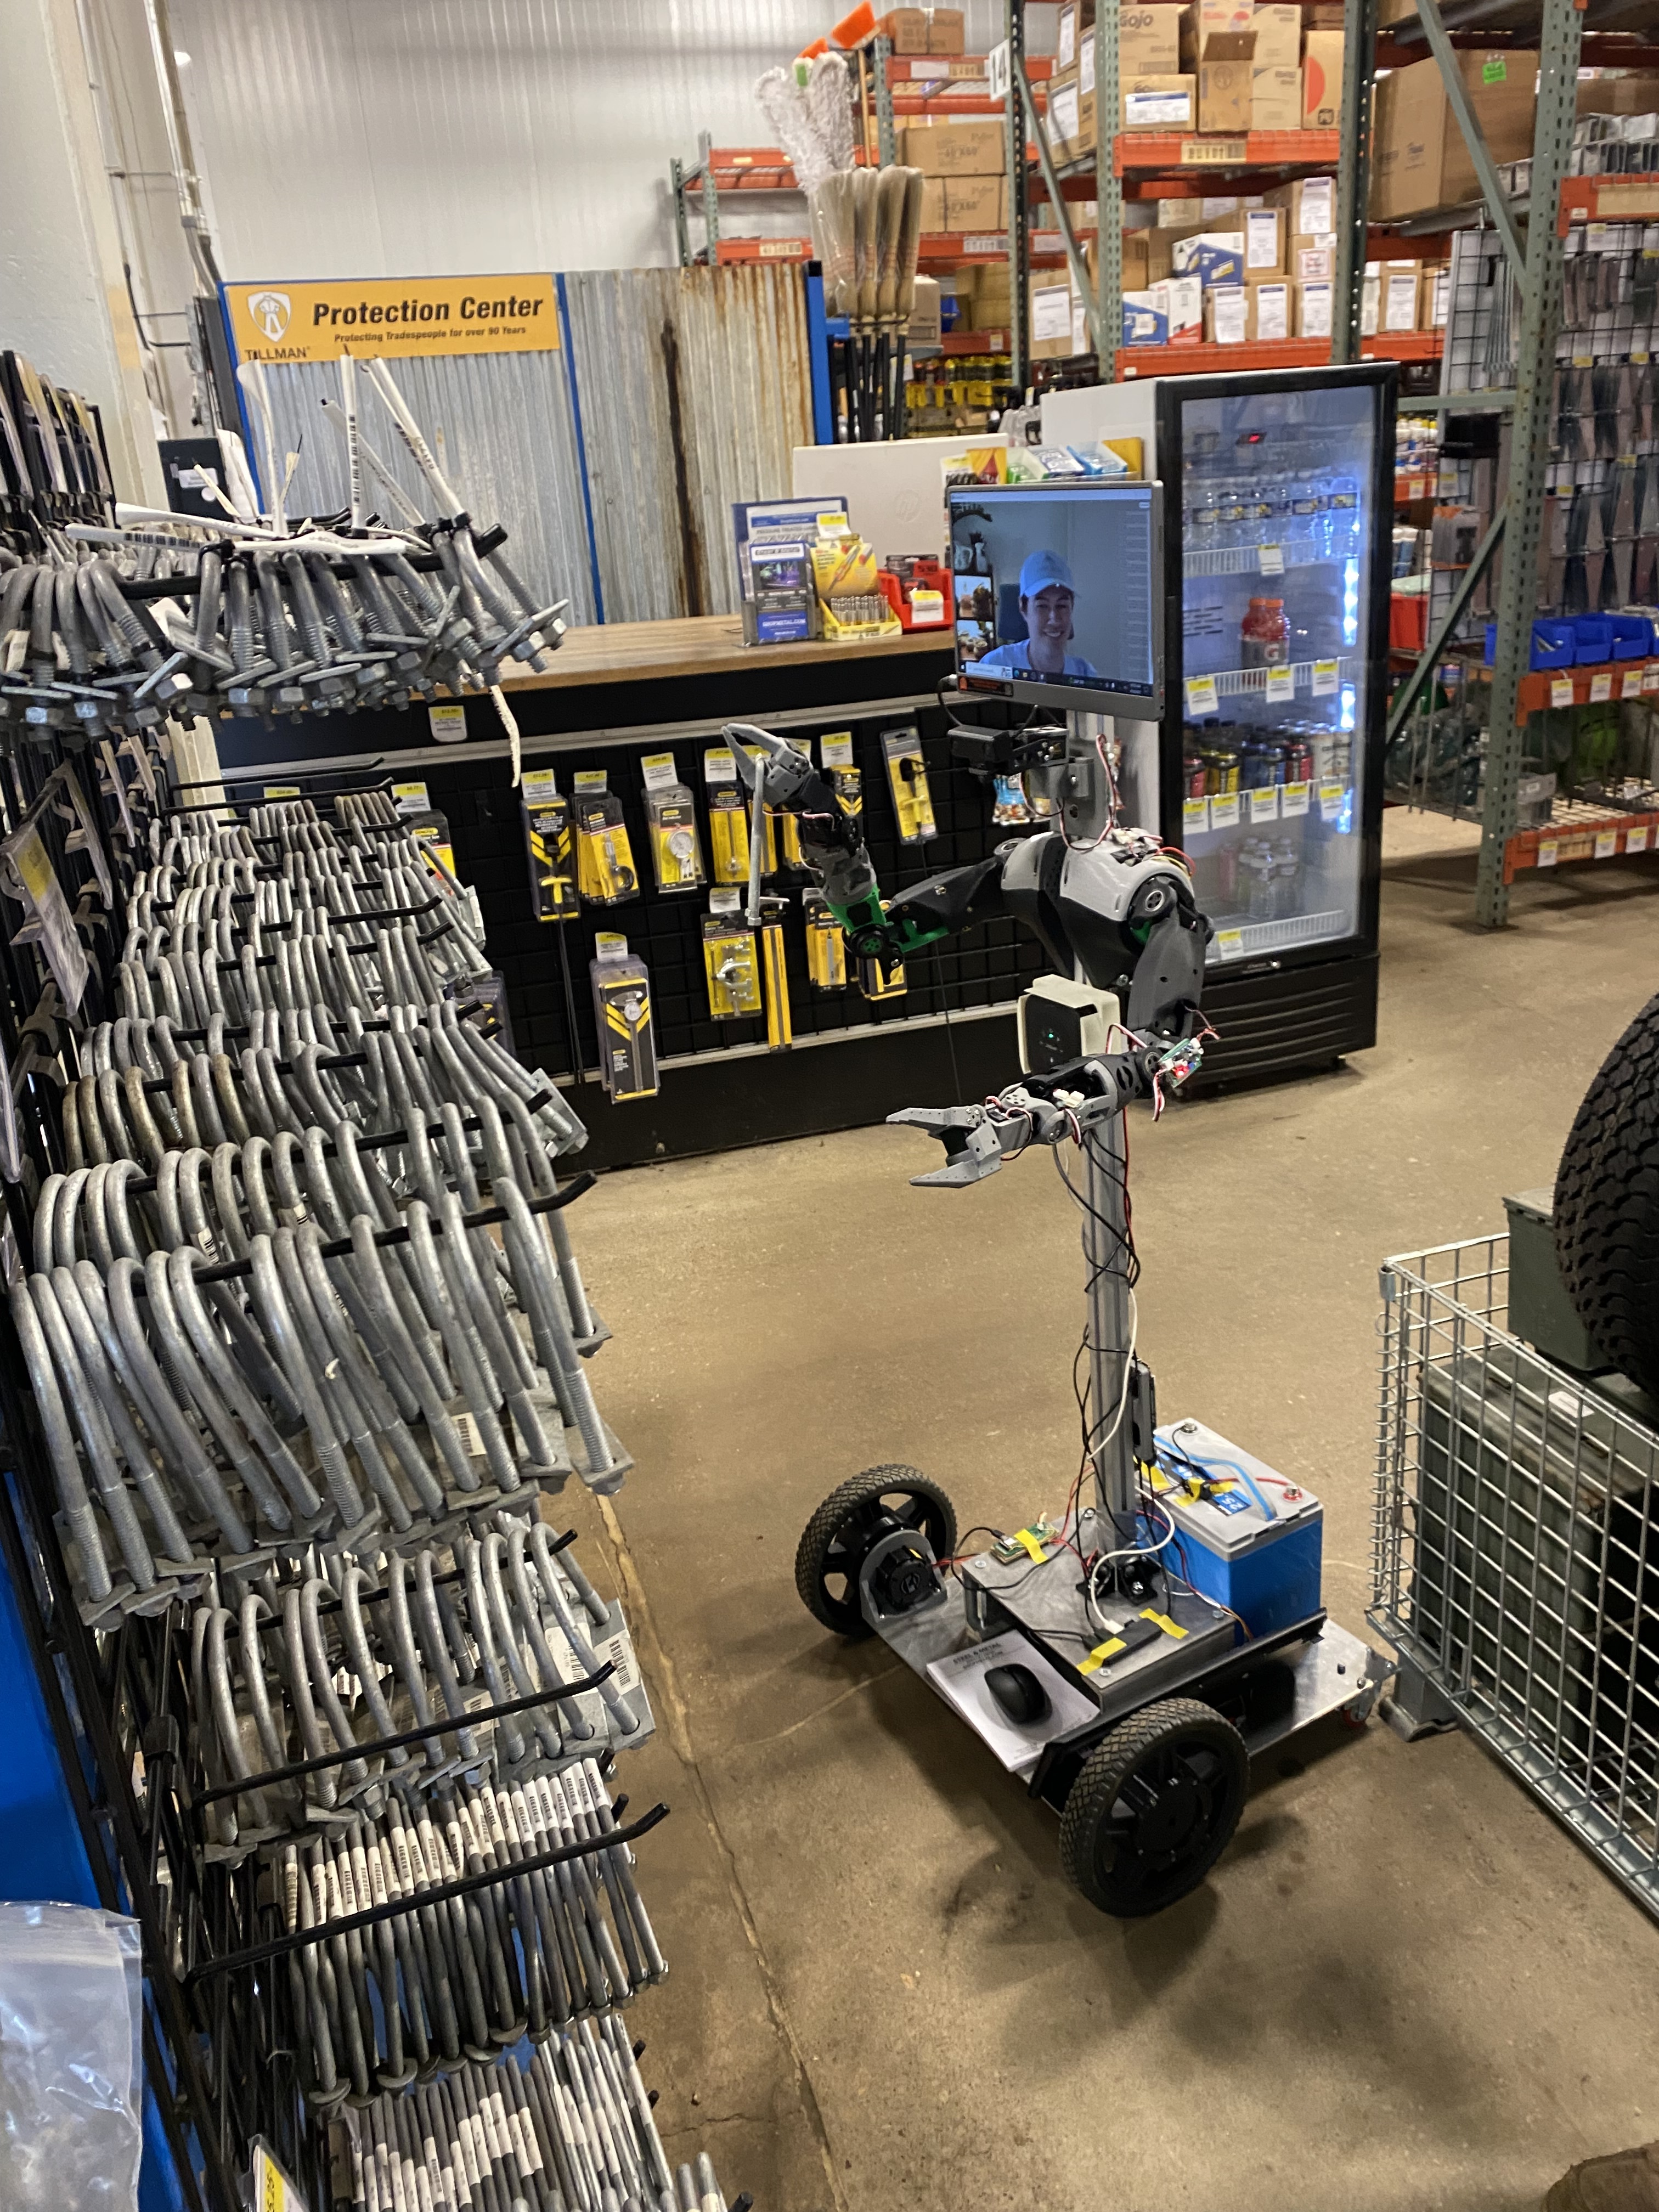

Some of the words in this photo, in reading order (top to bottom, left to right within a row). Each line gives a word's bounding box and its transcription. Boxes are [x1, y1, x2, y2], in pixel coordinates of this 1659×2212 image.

[313, 299, 449, 325] Protection
[460, 295, 544, 319] Center
[334, 332, 383, 342] Protecting
[386, 329, 446, 340] Tradespeople
[449, 328, 462, 336] for
[488, 326, 499, 335] 90
[503, 326, 526, 334] Years
